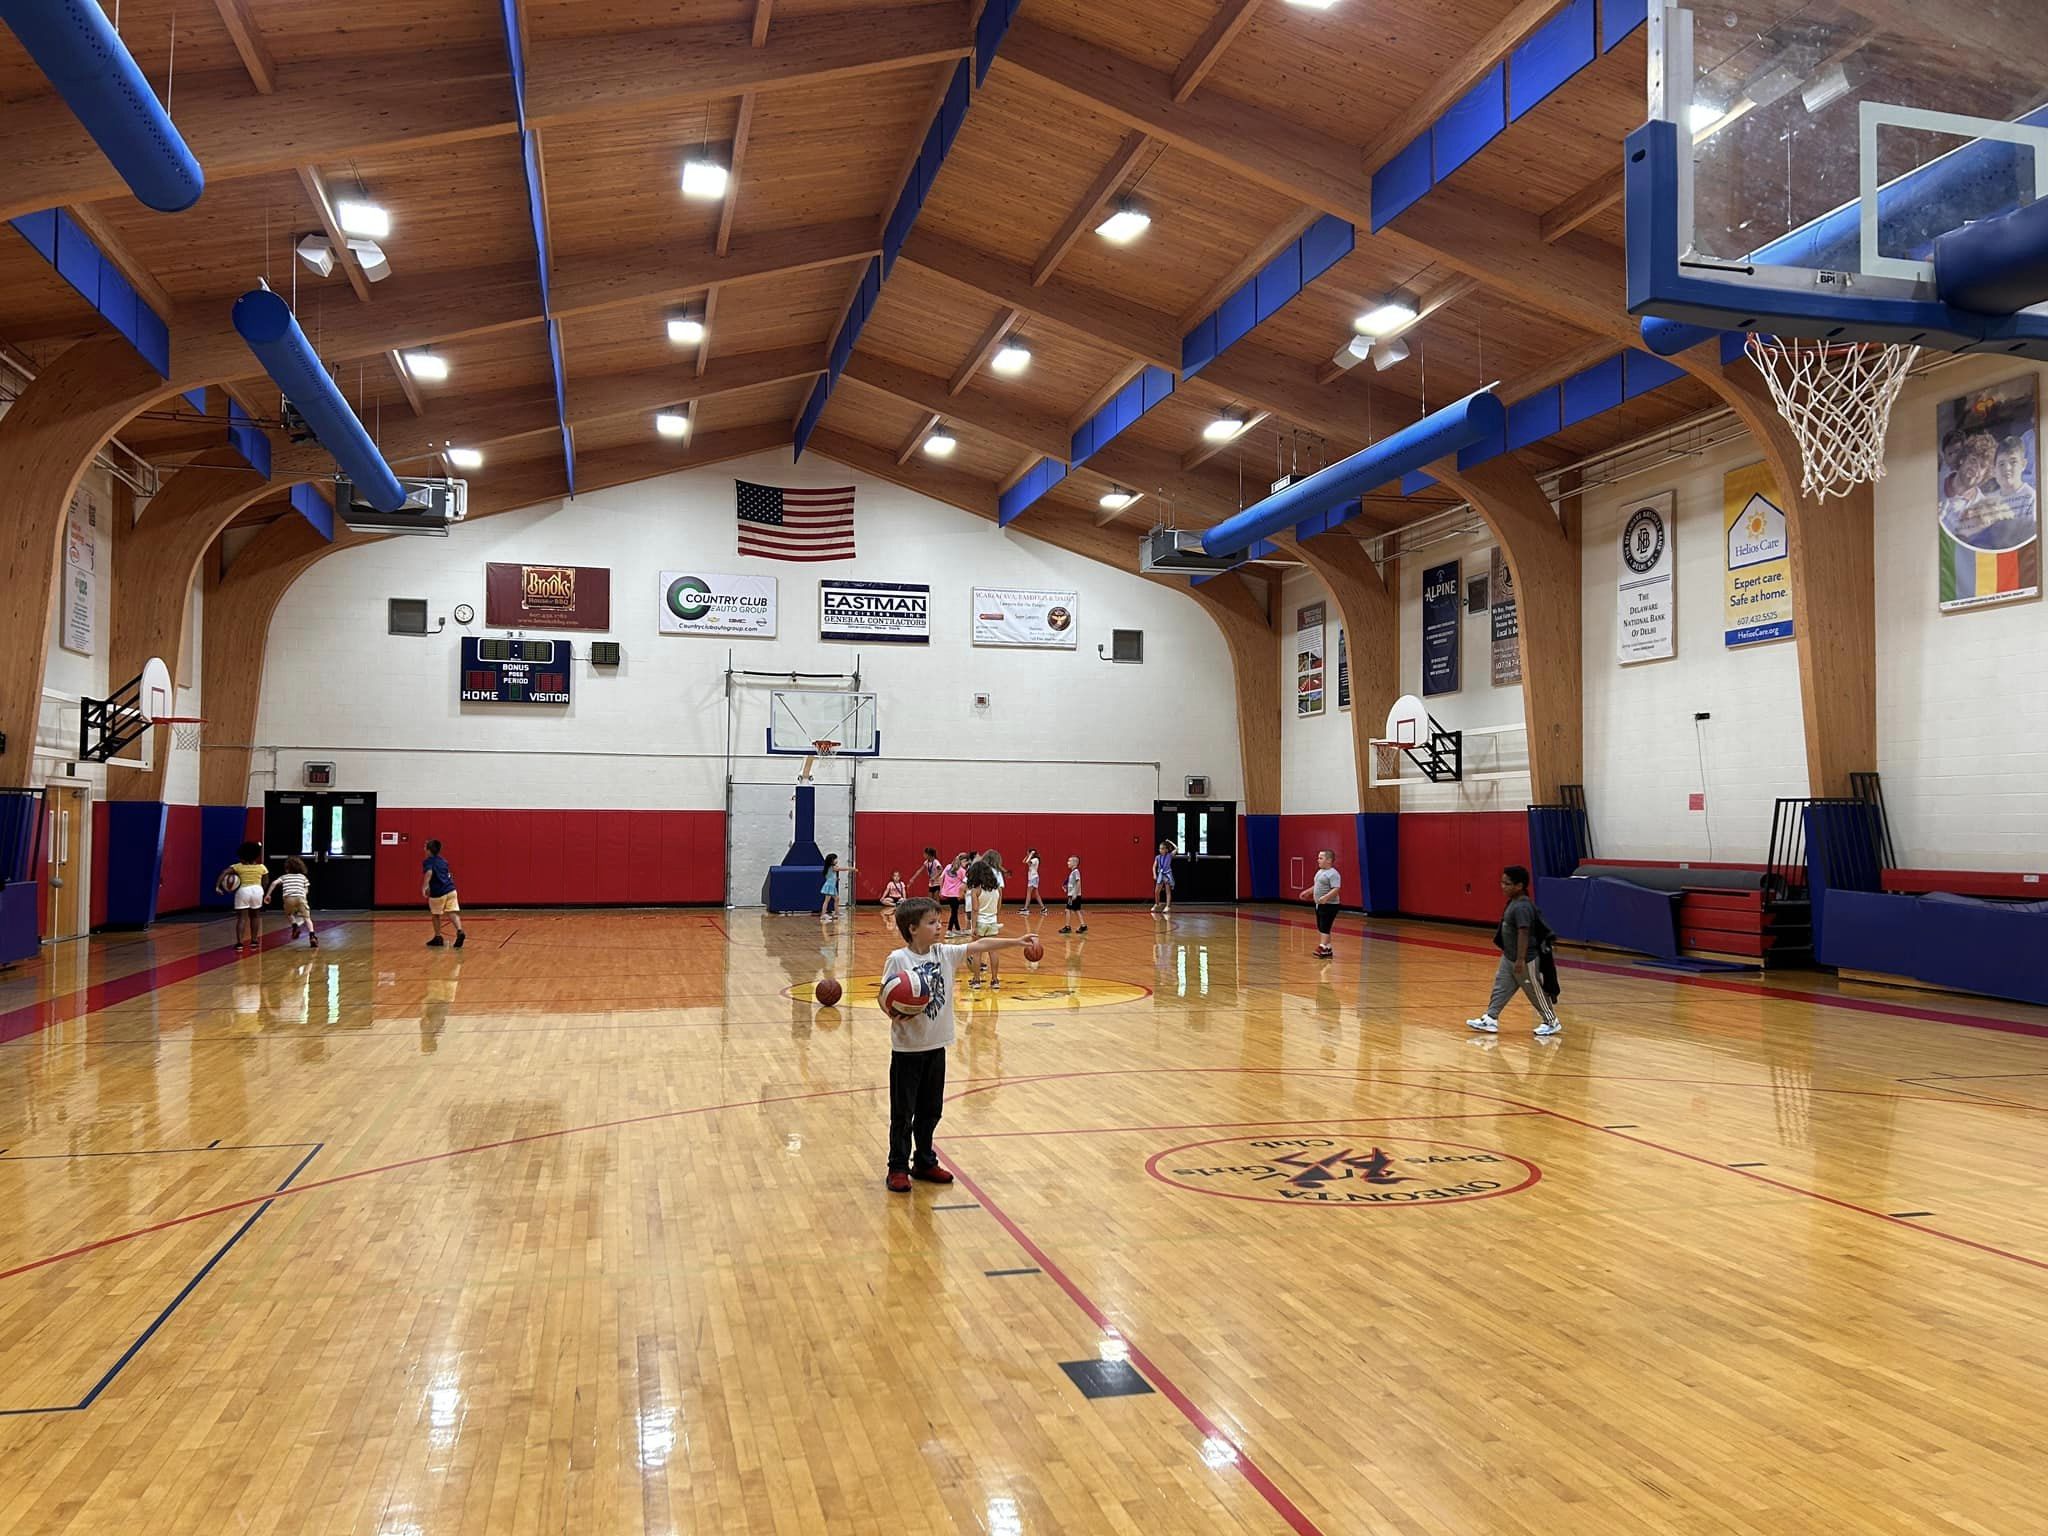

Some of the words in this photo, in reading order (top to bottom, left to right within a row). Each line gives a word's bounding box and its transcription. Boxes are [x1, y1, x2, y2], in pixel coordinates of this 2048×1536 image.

[527, 571, 571, 598] Brooks
[1734, 576, 1761, 592] Expert
[1762, 572, 1784, 583] care.
[1424, 579, 1457, 602] ALPINE
[685, 593, 738, 605] COUNTRY
[739, 596, 768, 607] CLUB
[824, 591, 927, 612] EASTMAN
[1730, 593, 1749, 607] Safe
[1750, 594, 1759, 604] at
[1760, 588, 1788, 601] home.
[714, 605, 738, 613] AUTO
[739, 606, 768, 614] GROUP
[1629, 603, 1658, 615] DELAWARE
[824, 615, 865, 623] GENERAL
[867, 617, 927, 626] CONTRACTORS
[1623, 617, 1650, 627] NATIONAL
[1650, 614, 1665, 623] BANK
[1737, 626, 1780, 640] HeliosCare.org
[502, 663, 530, 671] BONUS
[462, 690, 499, 701] HOME
[529, 692, 569, 702] VISITOR
[1250, 1139, 1335, 1149] Club
[1403, 1153, 1504, 1164] Boys
[1274, 1179, 1502, 1202] ONEONTA
